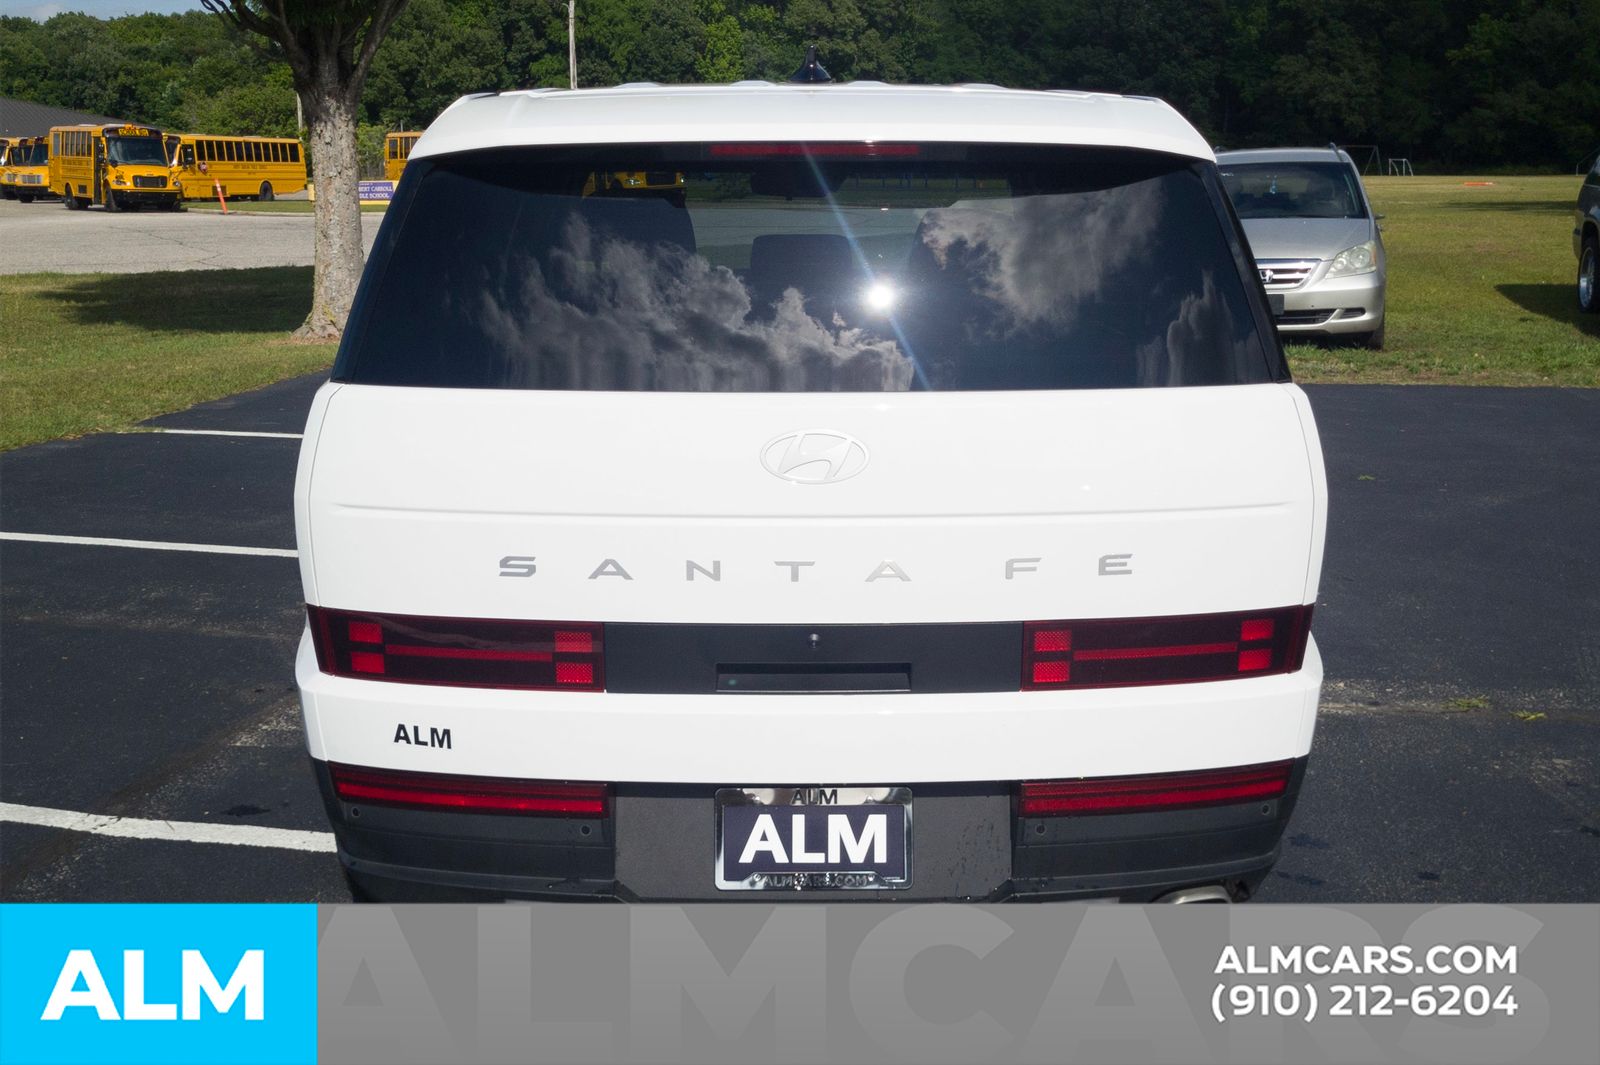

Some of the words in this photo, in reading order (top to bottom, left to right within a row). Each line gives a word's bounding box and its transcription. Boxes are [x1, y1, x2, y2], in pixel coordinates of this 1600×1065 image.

[499, 555, 912, 583] SANTA
[1005, 553, 1133, 580] FE
[394, 723, 451, 750] ALM
[791, 789, 838, 805] ALM
[738, 814, 887, 864] ALM
